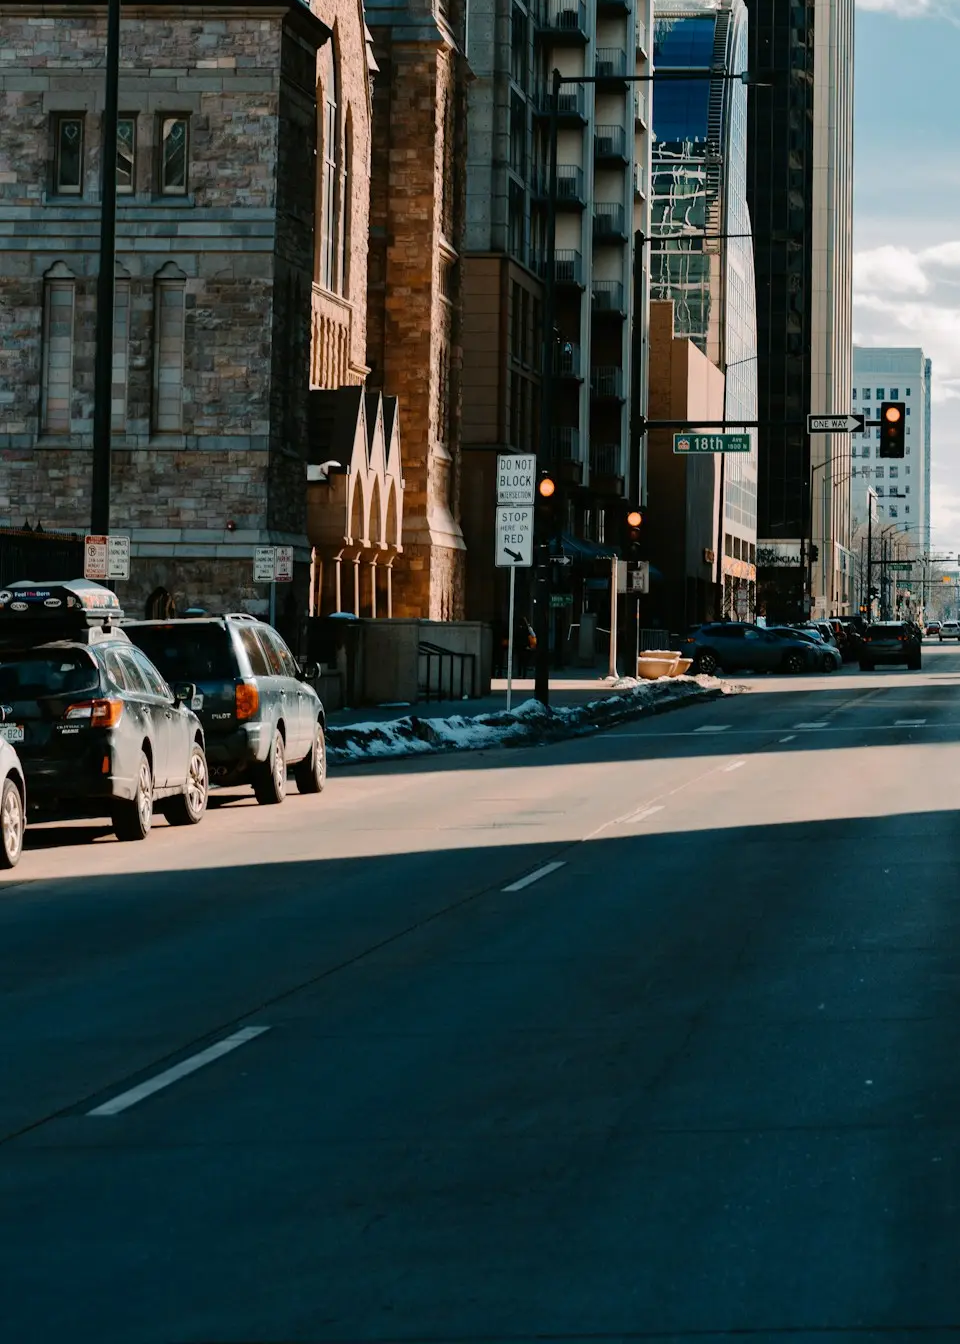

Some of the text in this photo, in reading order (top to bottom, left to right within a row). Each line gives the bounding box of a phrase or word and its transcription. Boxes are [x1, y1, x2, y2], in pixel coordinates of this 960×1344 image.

[813, 420, 847, 428] ONE WAY
[694, 437, 723, 450] 18th
[500, 459, 532, 470] DO NOT
[499, 475, 532, 487] BLOCK
[499, 490, 532, 499] INTERSECTION
[501, 512, 528, 522] STOP
[500, 524, 529, 532] HERE ON
[503, 534, 524, 544] RED
[211, 712, 232, 720] PILOT
